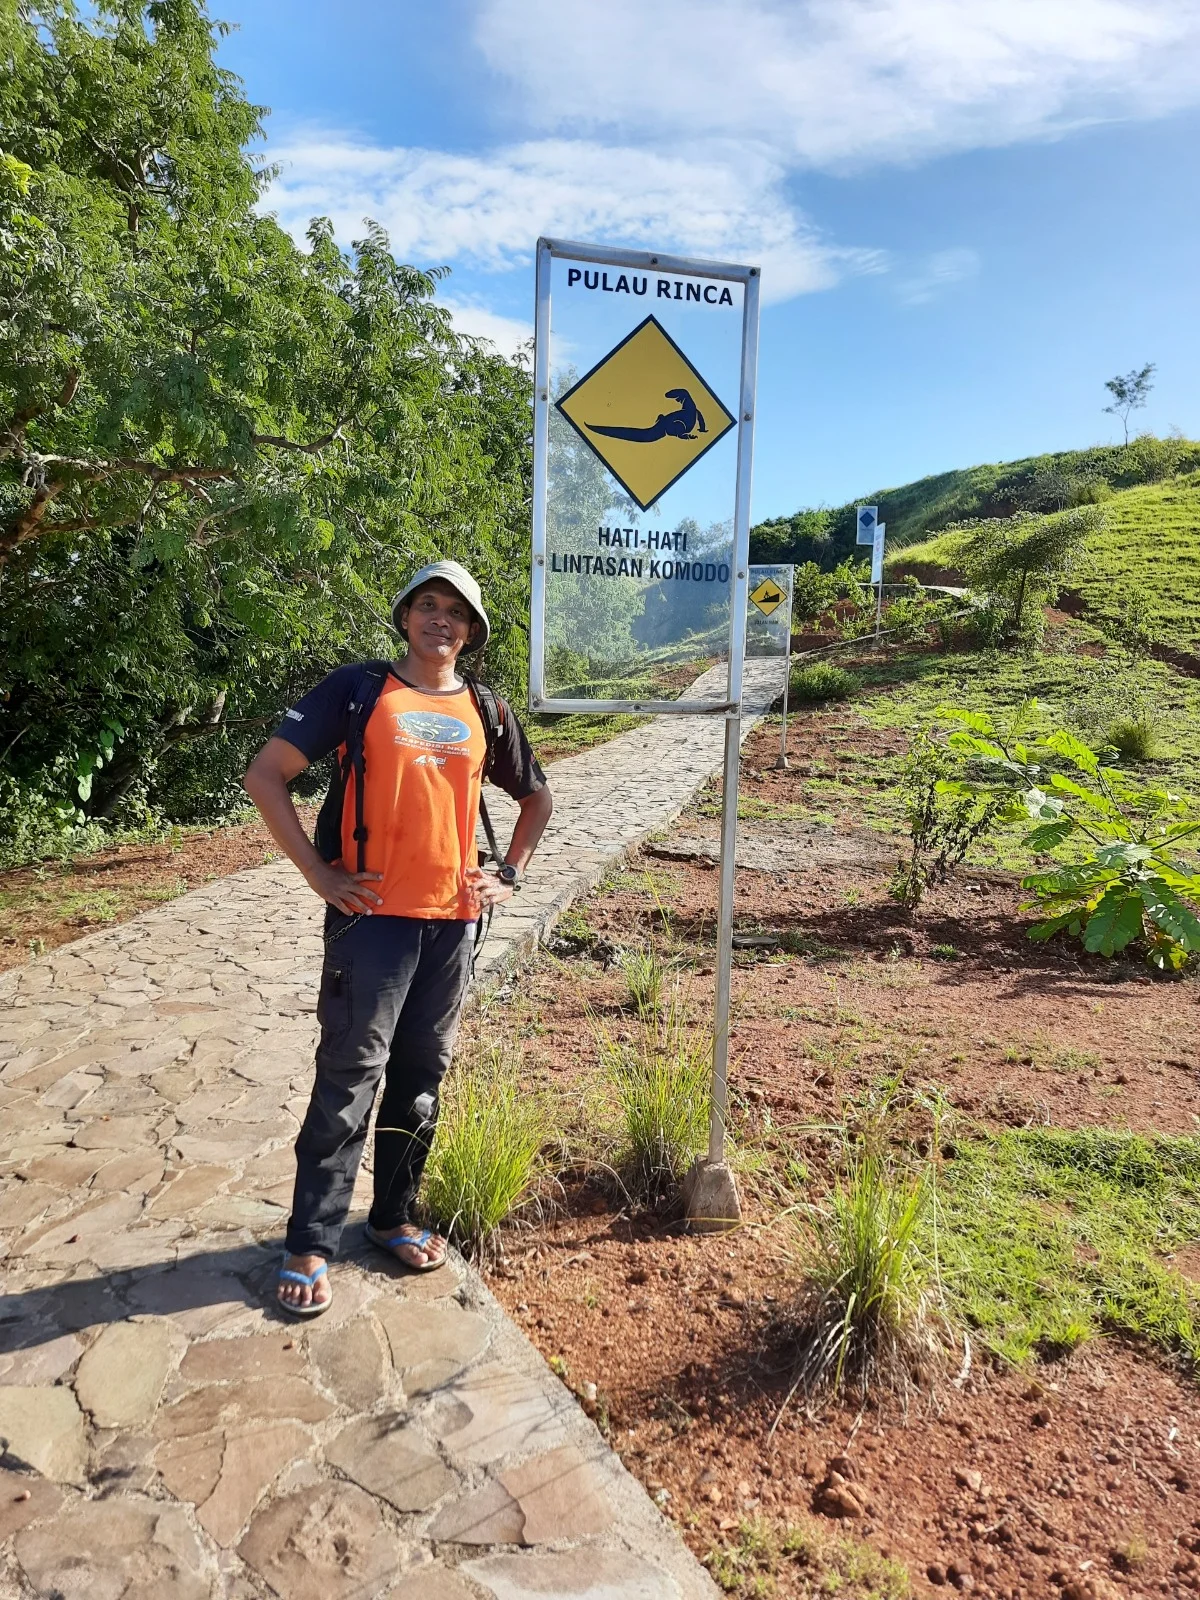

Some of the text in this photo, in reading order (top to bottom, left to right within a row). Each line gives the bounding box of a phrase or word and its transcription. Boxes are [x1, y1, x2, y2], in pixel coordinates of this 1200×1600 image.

[567, 268, 733, 306] PULAU RINCA
[599, 526, 687, 551] HATI-HATI
[552, 553, 729, 583] LINTASAN KOMODO
